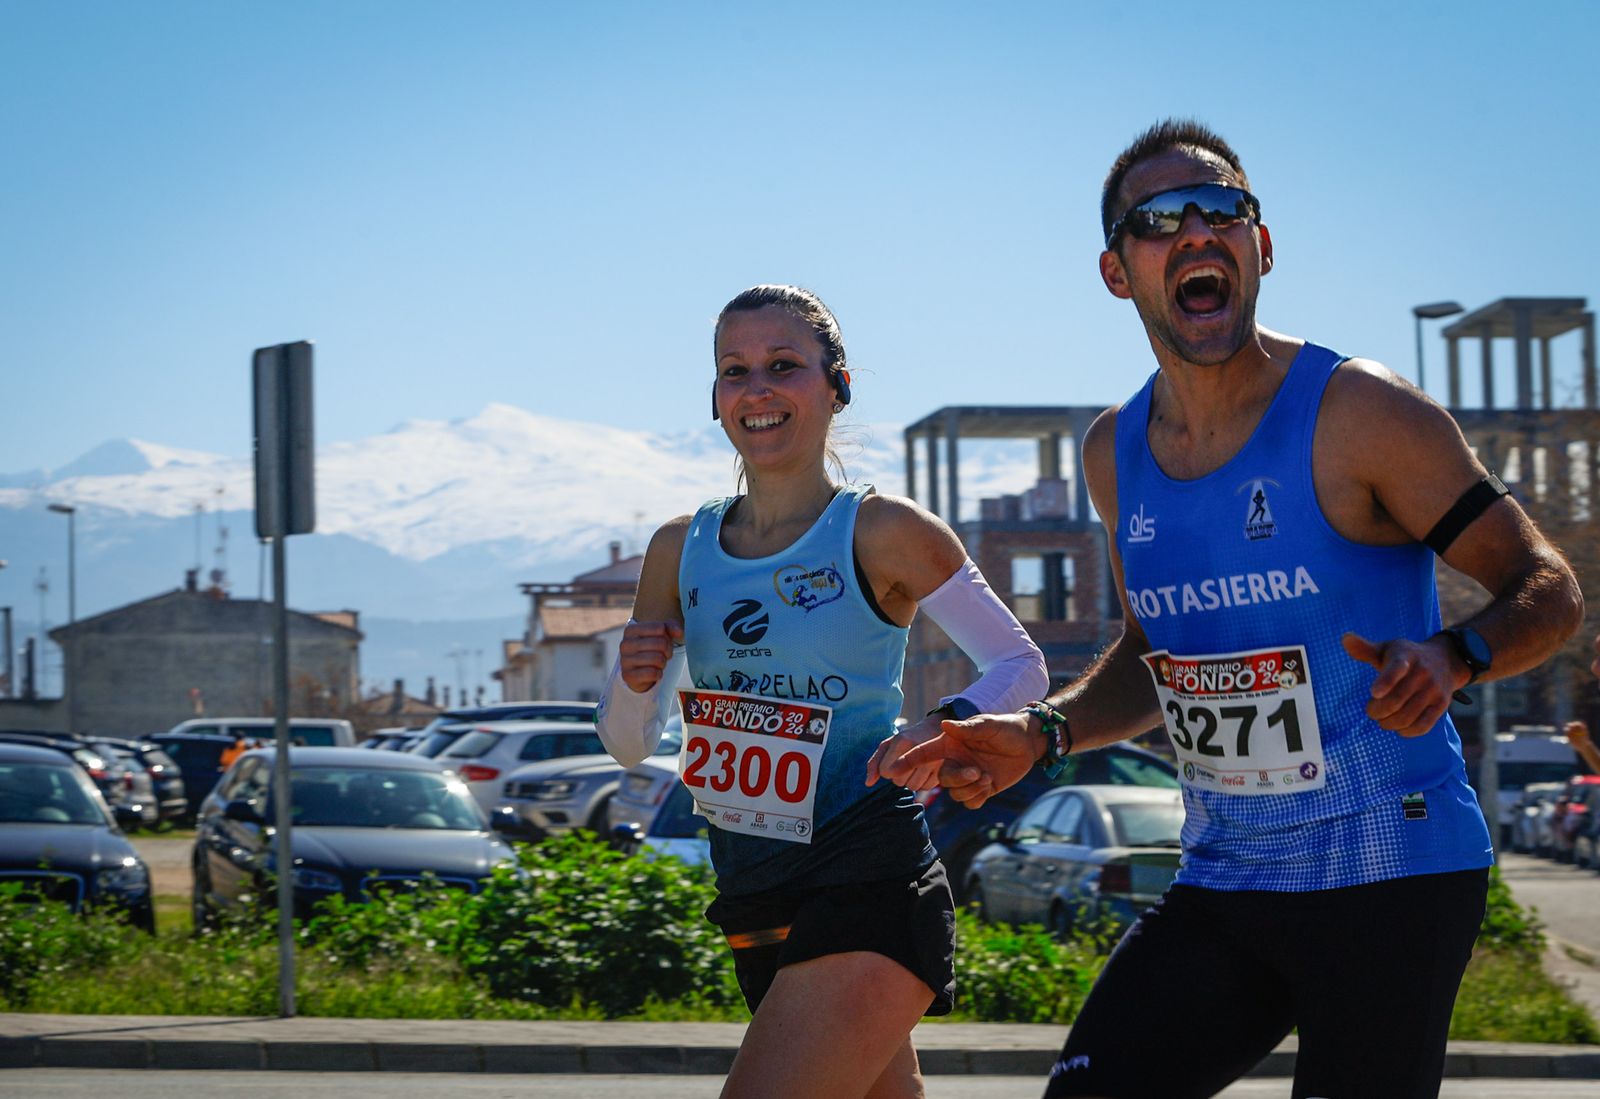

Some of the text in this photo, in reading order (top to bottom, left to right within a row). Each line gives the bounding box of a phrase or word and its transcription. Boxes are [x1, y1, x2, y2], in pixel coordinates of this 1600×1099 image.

[1126, 565, 1320, 619] ROTASIERRA
[1200, 661, 1242, 674] PREMIO
[1257, 659, 1276, 673] 20
[1175, 669, 1256, 692] FONDO
[1261, 670, 1280, 685] 26
[715, 698, 739, 710] GRAN
[738, 701, 775, 716] PREMIO
[712, 706, 784, 733] FONDO
[785, 711, 804, 724] 20
[784, 723, 804, 736] 26
[1166, 697, 1304, 758] 3271
[683, 736, 812, 804] 2300
